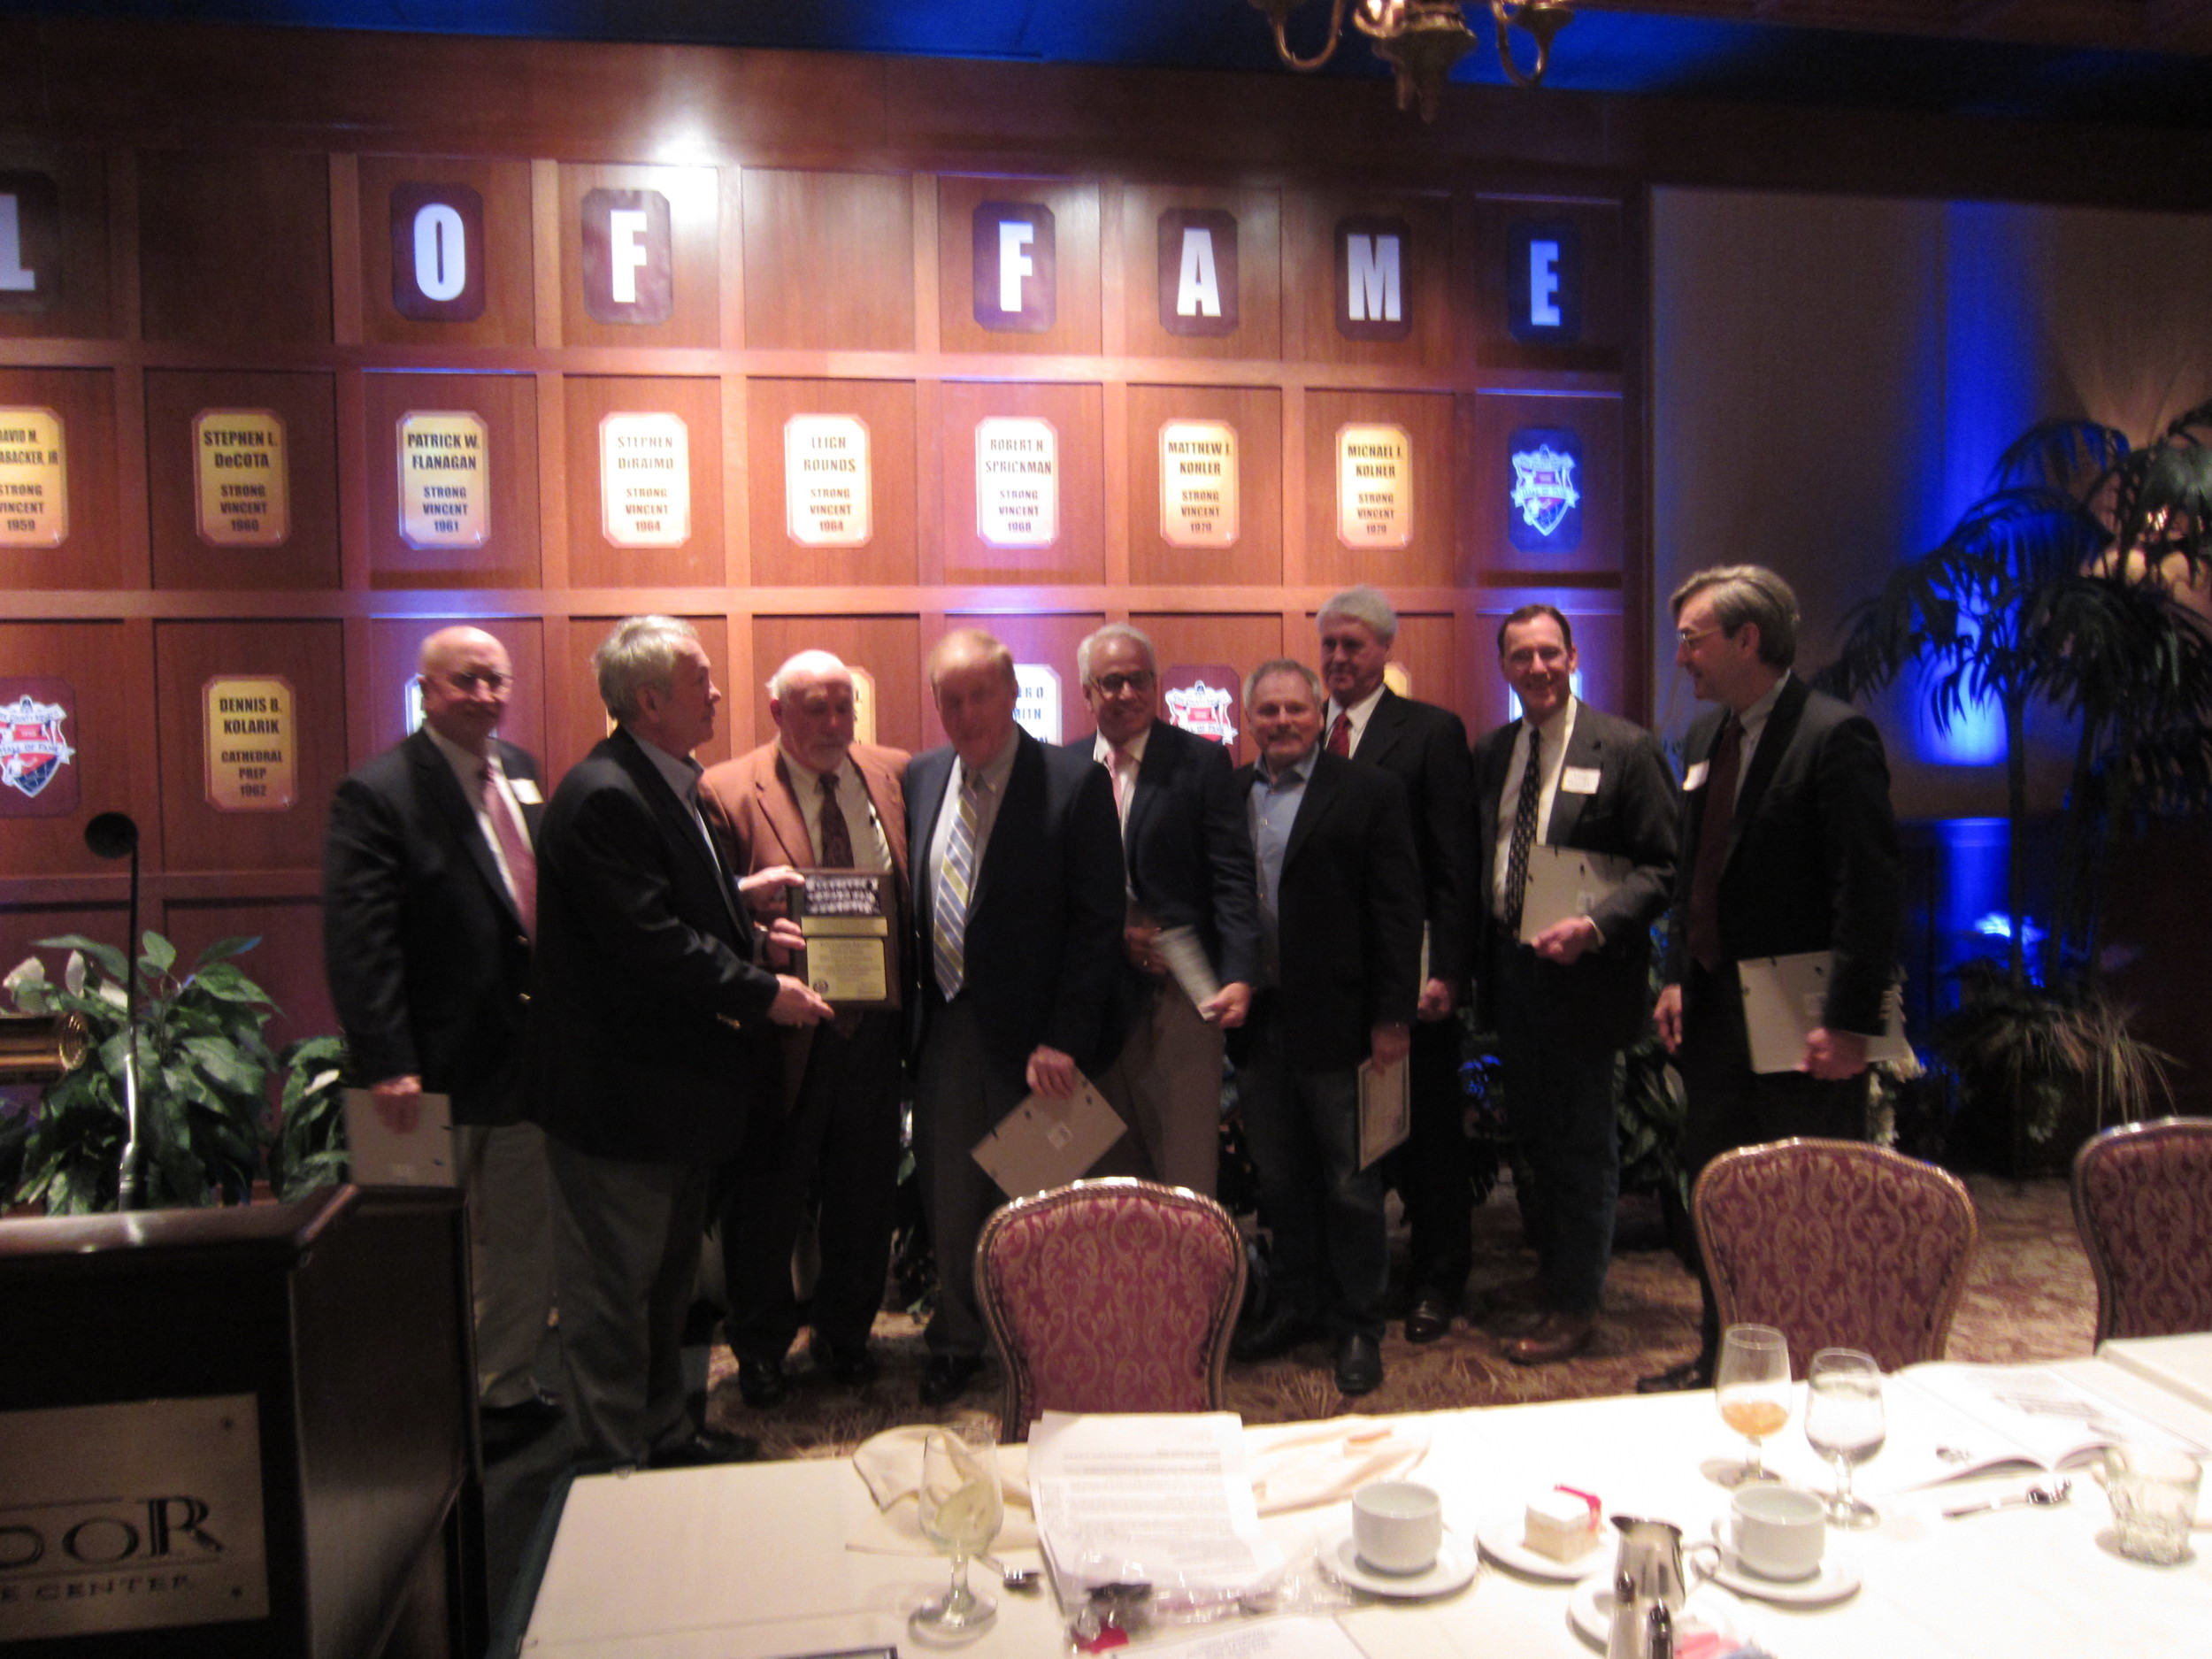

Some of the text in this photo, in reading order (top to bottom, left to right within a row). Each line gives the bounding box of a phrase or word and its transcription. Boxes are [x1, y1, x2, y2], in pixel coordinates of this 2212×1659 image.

[204, 431, 264, 447] STEPHEN
[408, 433, 461, 447] PATRICK
[618, 436, 672, 449] STEPHEN
[812, 436, 846, 449] LEIGH
[990, 439, 1032, 451] ROBERT
[1168, 442, 1222, 456] MATTHEW
[1348, 444, 1394, 458] MICHAEL
[214, 452, 269, 468] DeCOTA
[412, 455, 477, 470] FLANAGAN
[986, 460, 1051, 474] SPRICKMAN
[0, 485, 42, 496] STRONG
[221, 485, 265, 497] STRONG
[424, 486, 466, 498] STRONG
[626, 488, 667, 498] STRONG
[810, 488, 850, 499] STRONG
[1000, 490, 1038, 500] STRONG
[1182, 490, 1219, 502] STRONG
[1358, 493, 1394, 504] STRONG
[0, 502, 44, 514] VINCENT
[220, 502, 267, 514] VINCENT
[423, 503, 467, 515] VINCENT
[626, 504, 668, 515] VINCENT
[810, 504, 851, 516] VINCENT
[999, 505, 1039, 517] VINCENT
[1181, 506, 1219, 518] VINCENT
[1357, 508, 1394, 520] VINCENT
[434, 520, 459, 532] 1961
[635, 520, 661, 532] 1964
[819, 520, 843, 532] 1964
[219, 697, 267, 712] DENNIS
[1013, 708, 1041, 720] MITH
[223, 719, 280, 733] KOLARIK
[221, 750, 283, 763] CATHEDRAL
[239, 768, 266, 780] PREP
[0, 1495, 225, 1571] DOR
[35, 1575, 189, 1601] CENTER
